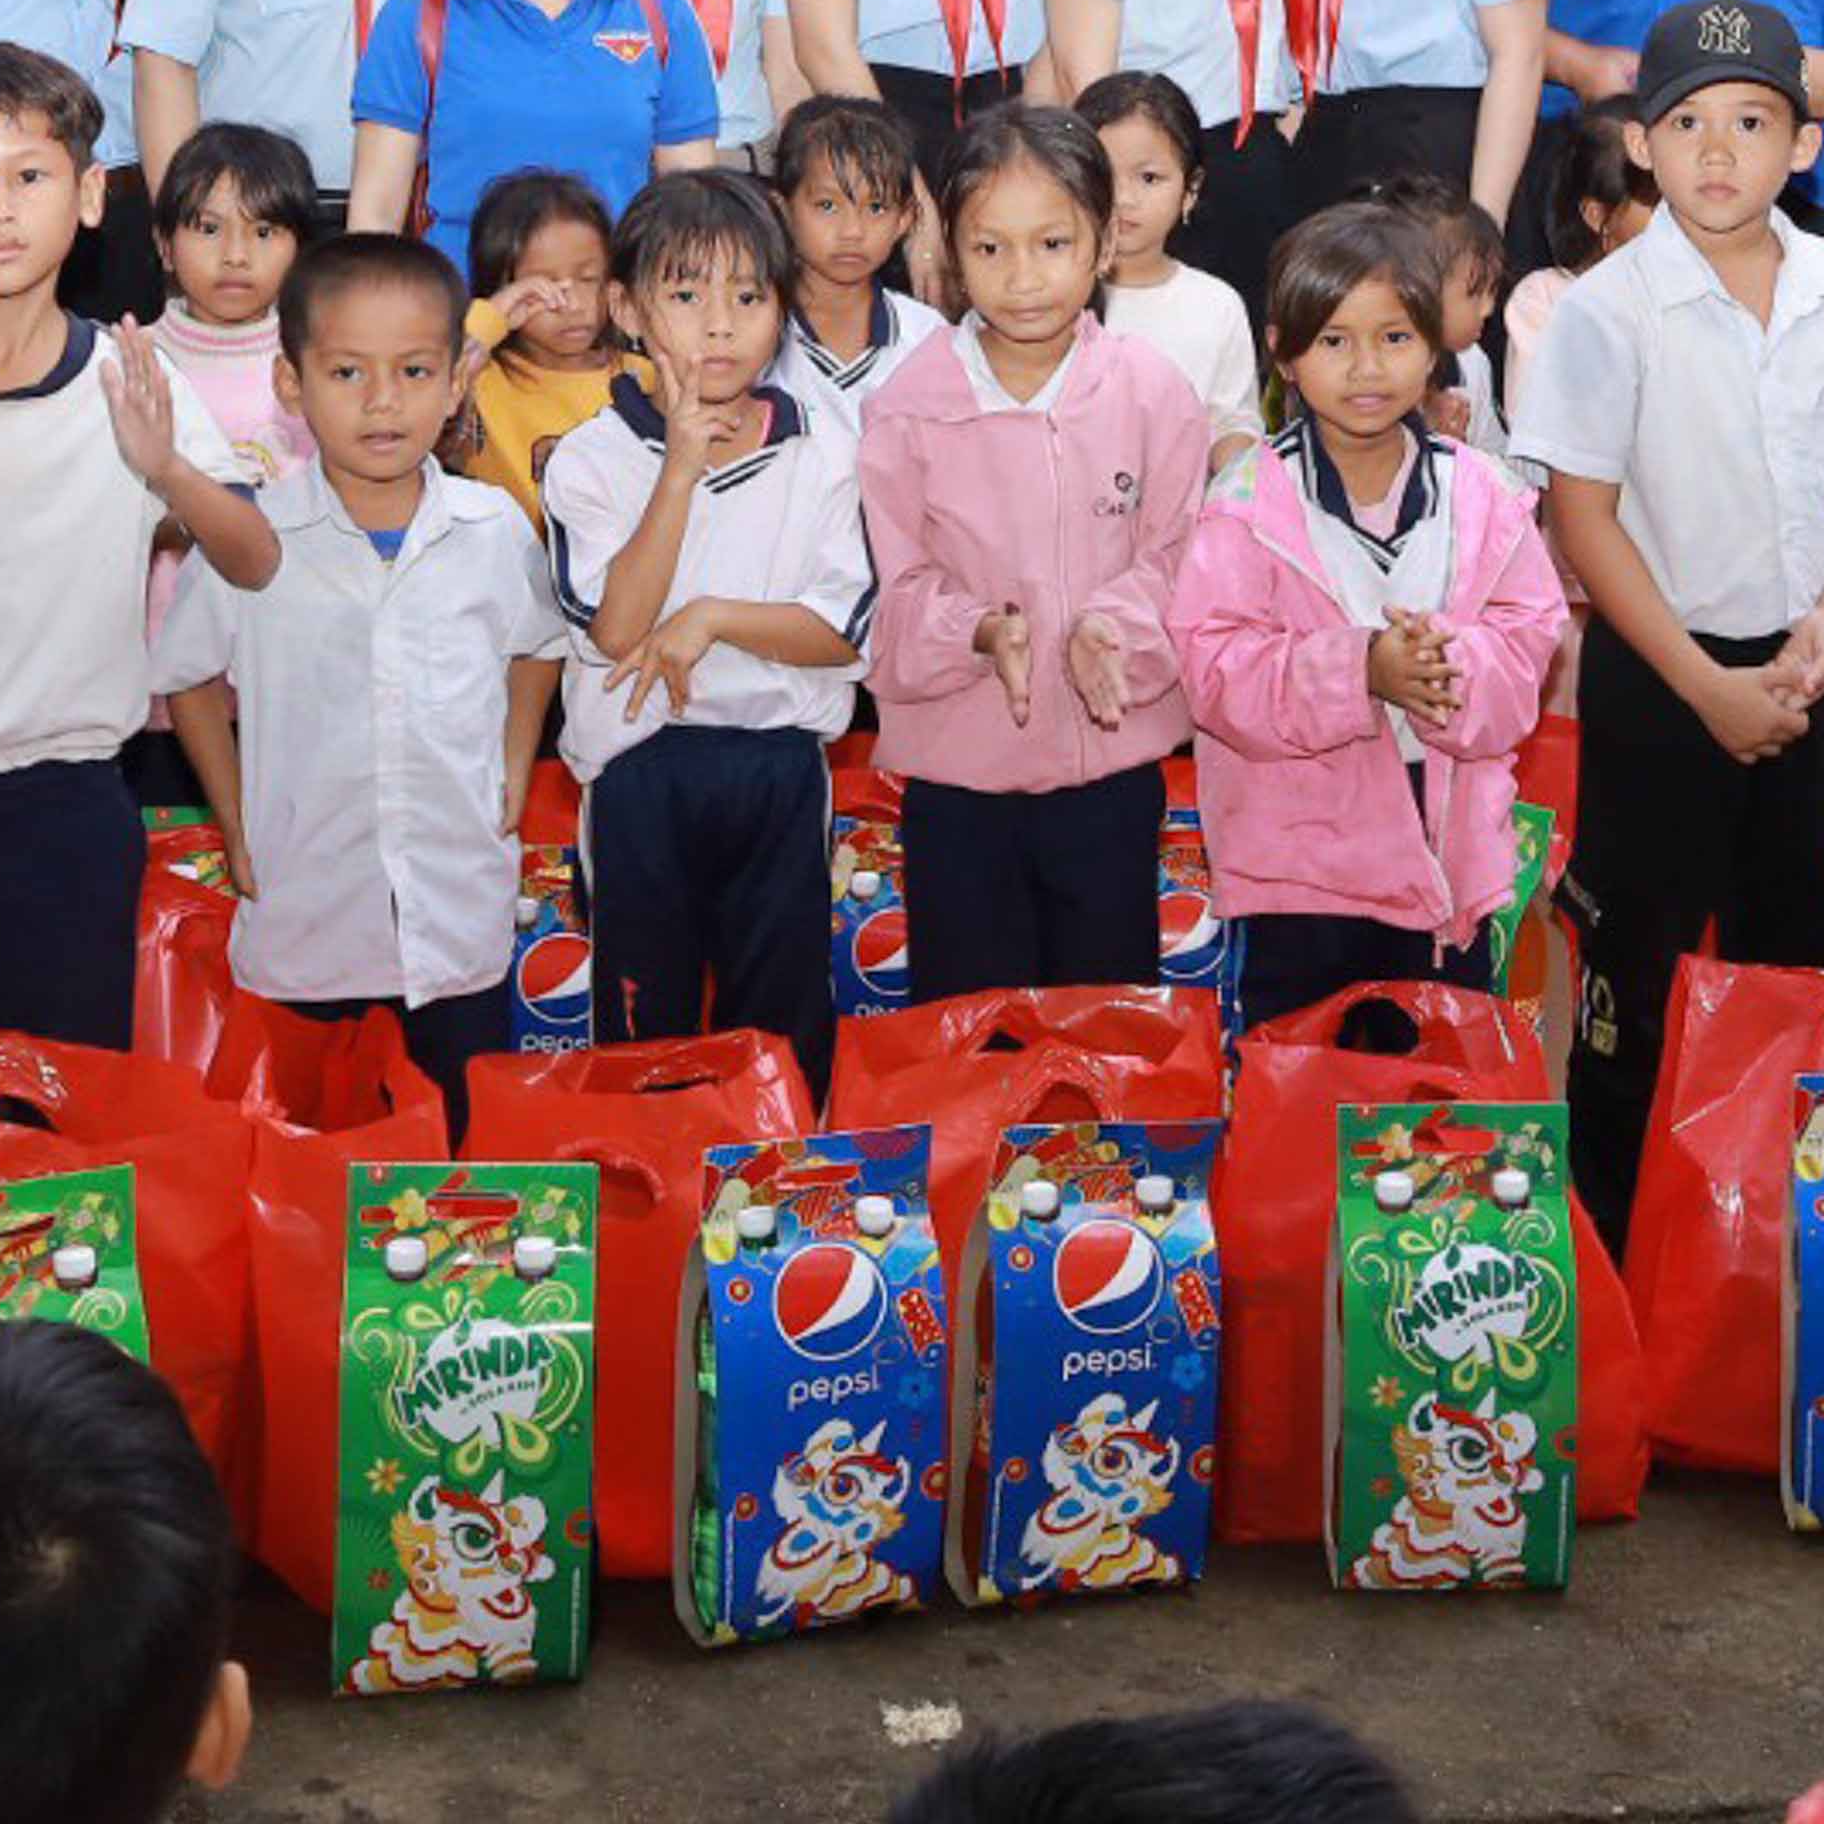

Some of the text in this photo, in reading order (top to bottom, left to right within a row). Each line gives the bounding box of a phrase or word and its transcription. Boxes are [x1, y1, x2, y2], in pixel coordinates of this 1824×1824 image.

[1394, 1242, 1543, 1351] MIRINDA
[395, 1317, 556, 1428] MIRINDA
[787, 1367, 880, 1412] pepsi
[1062, 1342, 1154, 1382] pepsi
